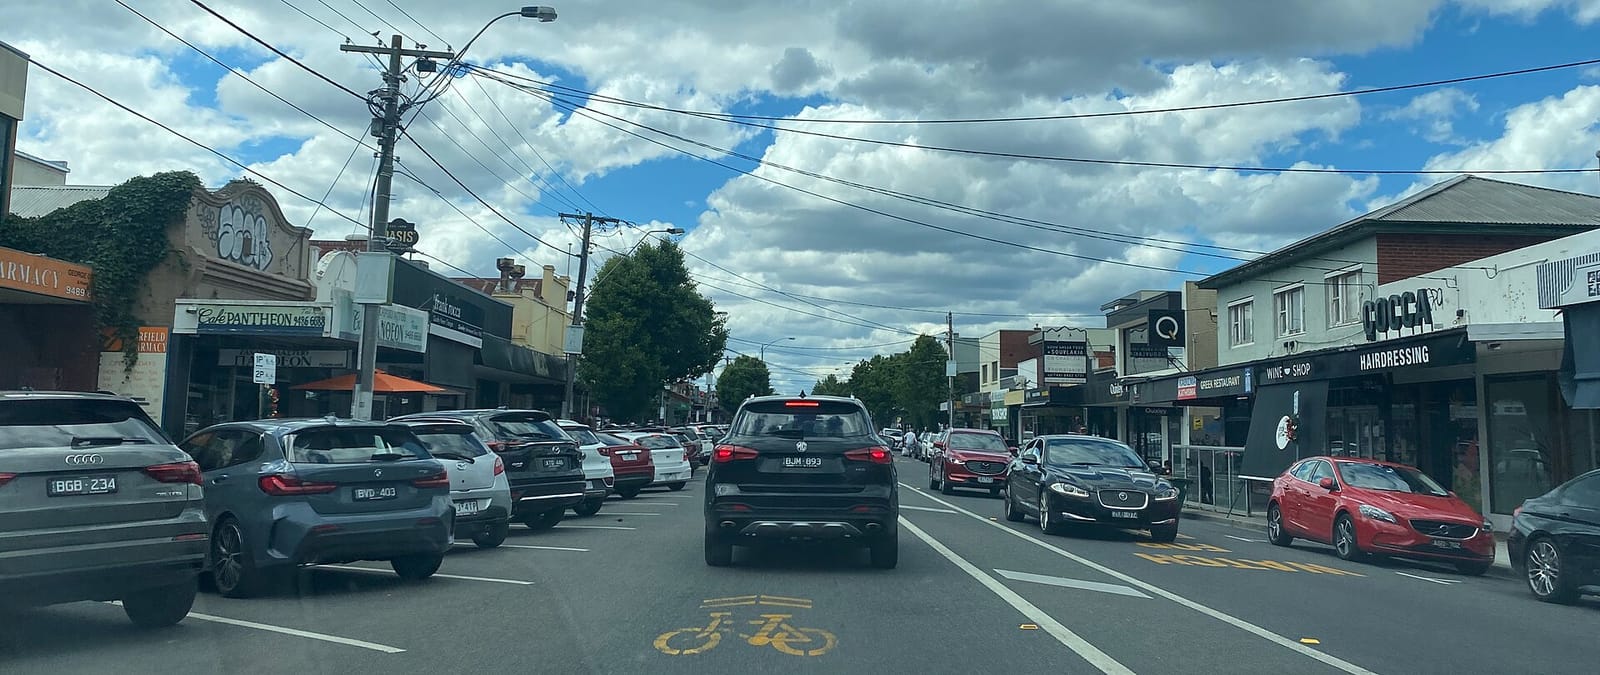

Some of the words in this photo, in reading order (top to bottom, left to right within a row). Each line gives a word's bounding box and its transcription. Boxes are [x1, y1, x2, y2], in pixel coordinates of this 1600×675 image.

[227, 311, 293, 326] PANTHEON
[1363, 288, 1432, 337] COCCA
[1155, 316, 1178, 340] Q
[1360, 346, 1429, 370] HAIRDRESSING
[1266, 366, 1283, 380] WINE
[1291, 362, 1311, 377] SHOP
[1200, 379, 1213, 390] GREEK
[1213, 375, 1240, 388] RESTAURANT
